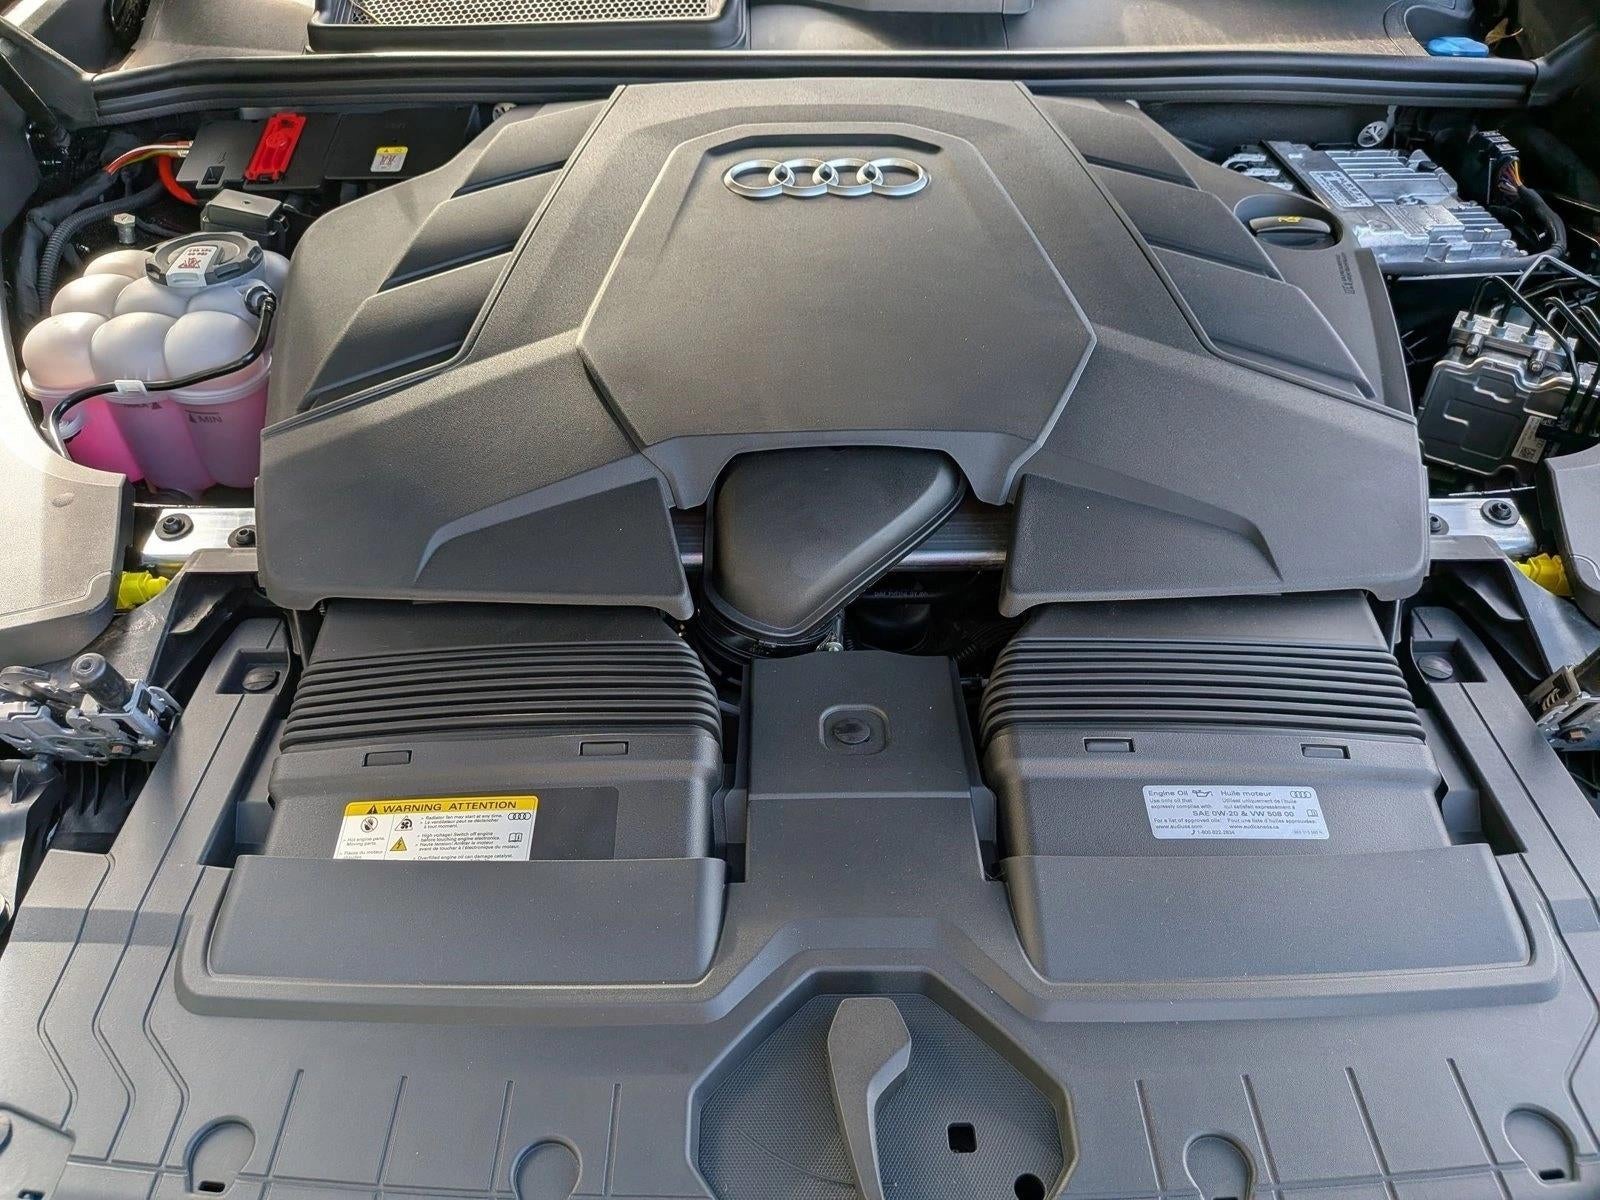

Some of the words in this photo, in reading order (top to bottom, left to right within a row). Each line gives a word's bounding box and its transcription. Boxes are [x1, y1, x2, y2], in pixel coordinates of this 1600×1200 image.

[198, 415, 222, 424] MIN
[383, 803, 442, 813] WARNING
[448, 801, 517, 811] ATTENTION
